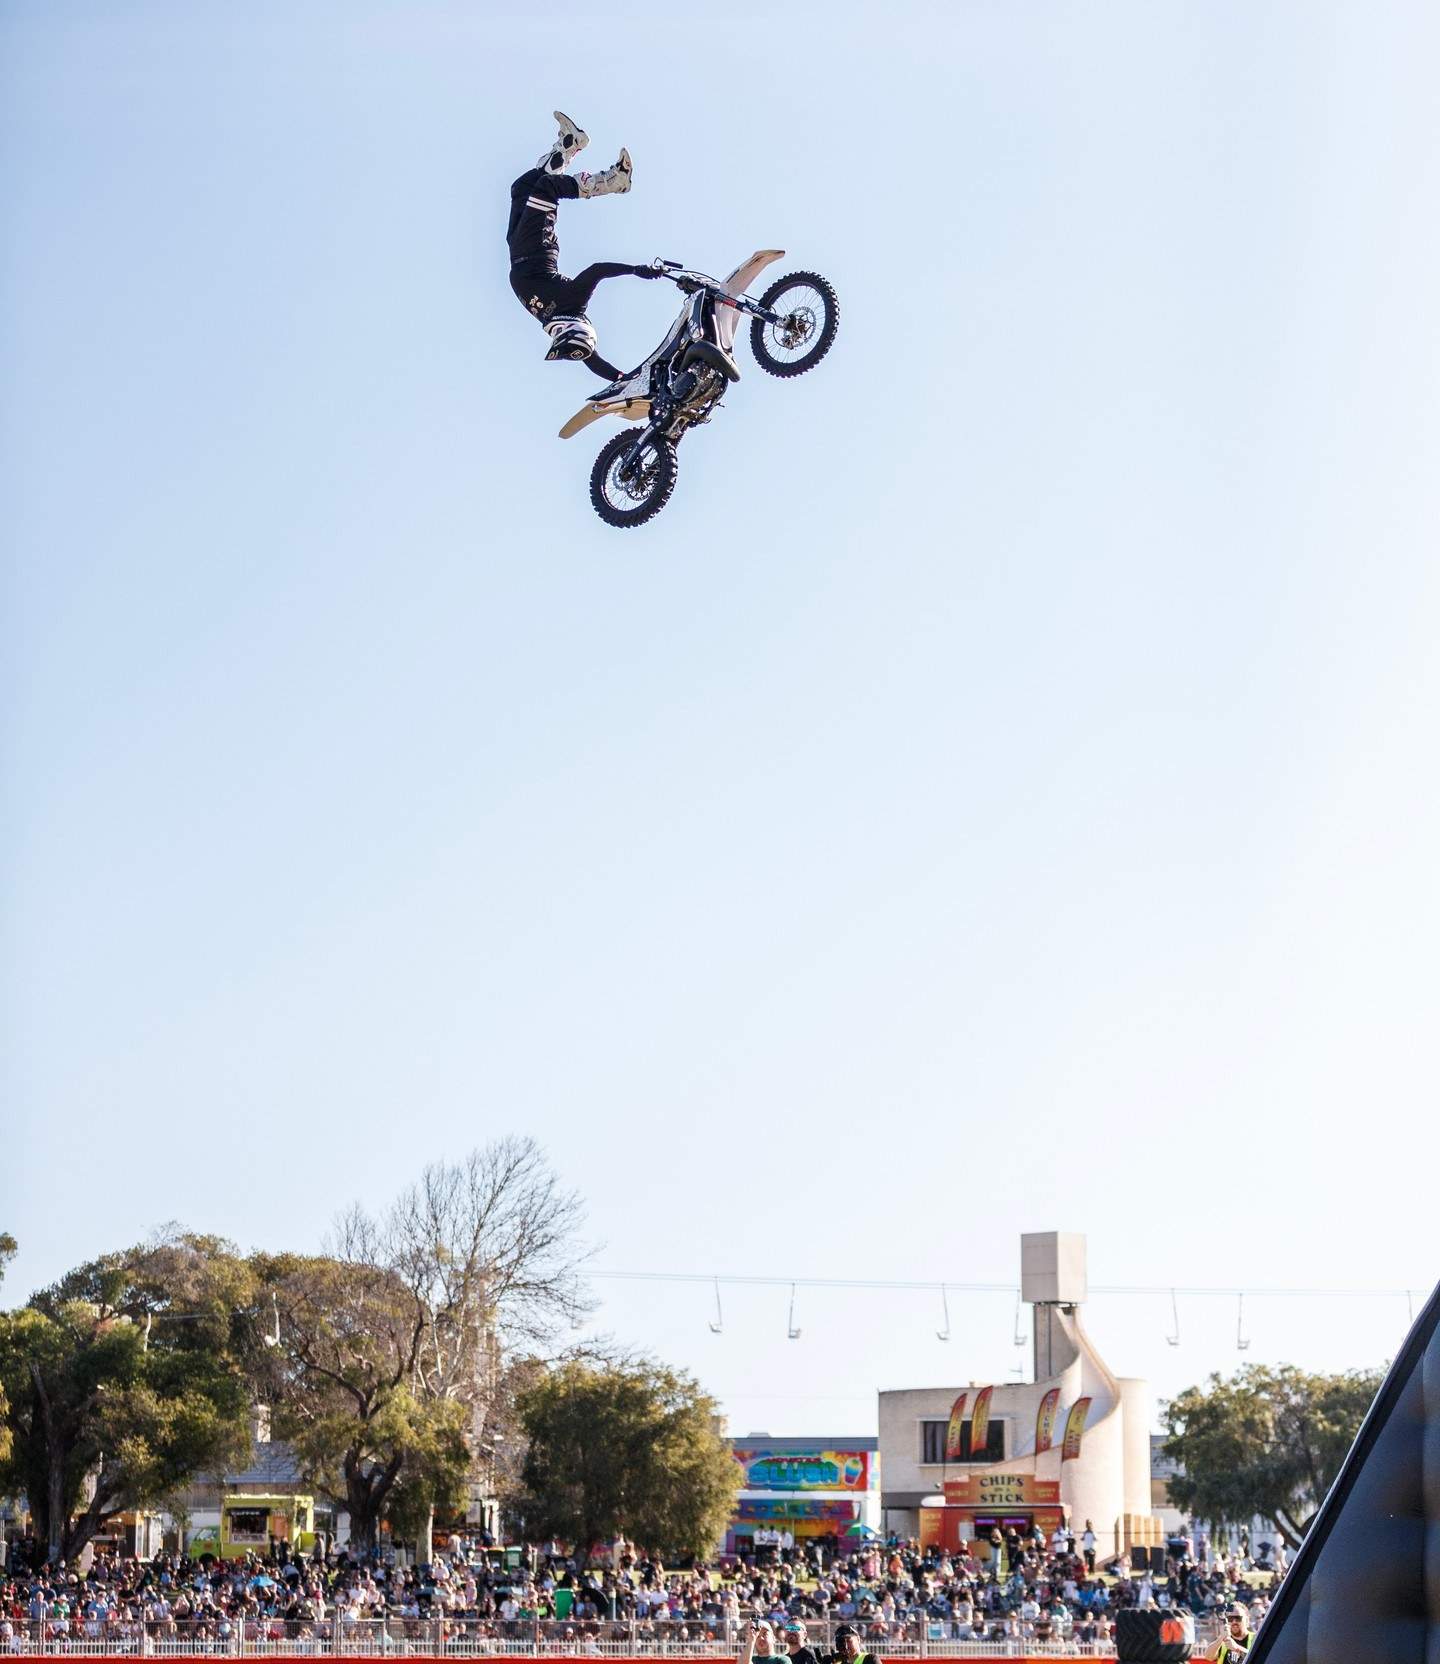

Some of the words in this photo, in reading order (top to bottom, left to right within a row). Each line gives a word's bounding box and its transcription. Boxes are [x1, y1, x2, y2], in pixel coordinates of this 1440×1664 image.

[748, 1462, 839, 1483] SLUSH
[980, 1475, 1024, 1487] CHIPS
[980, 1493, 1024, 1503] STICK
